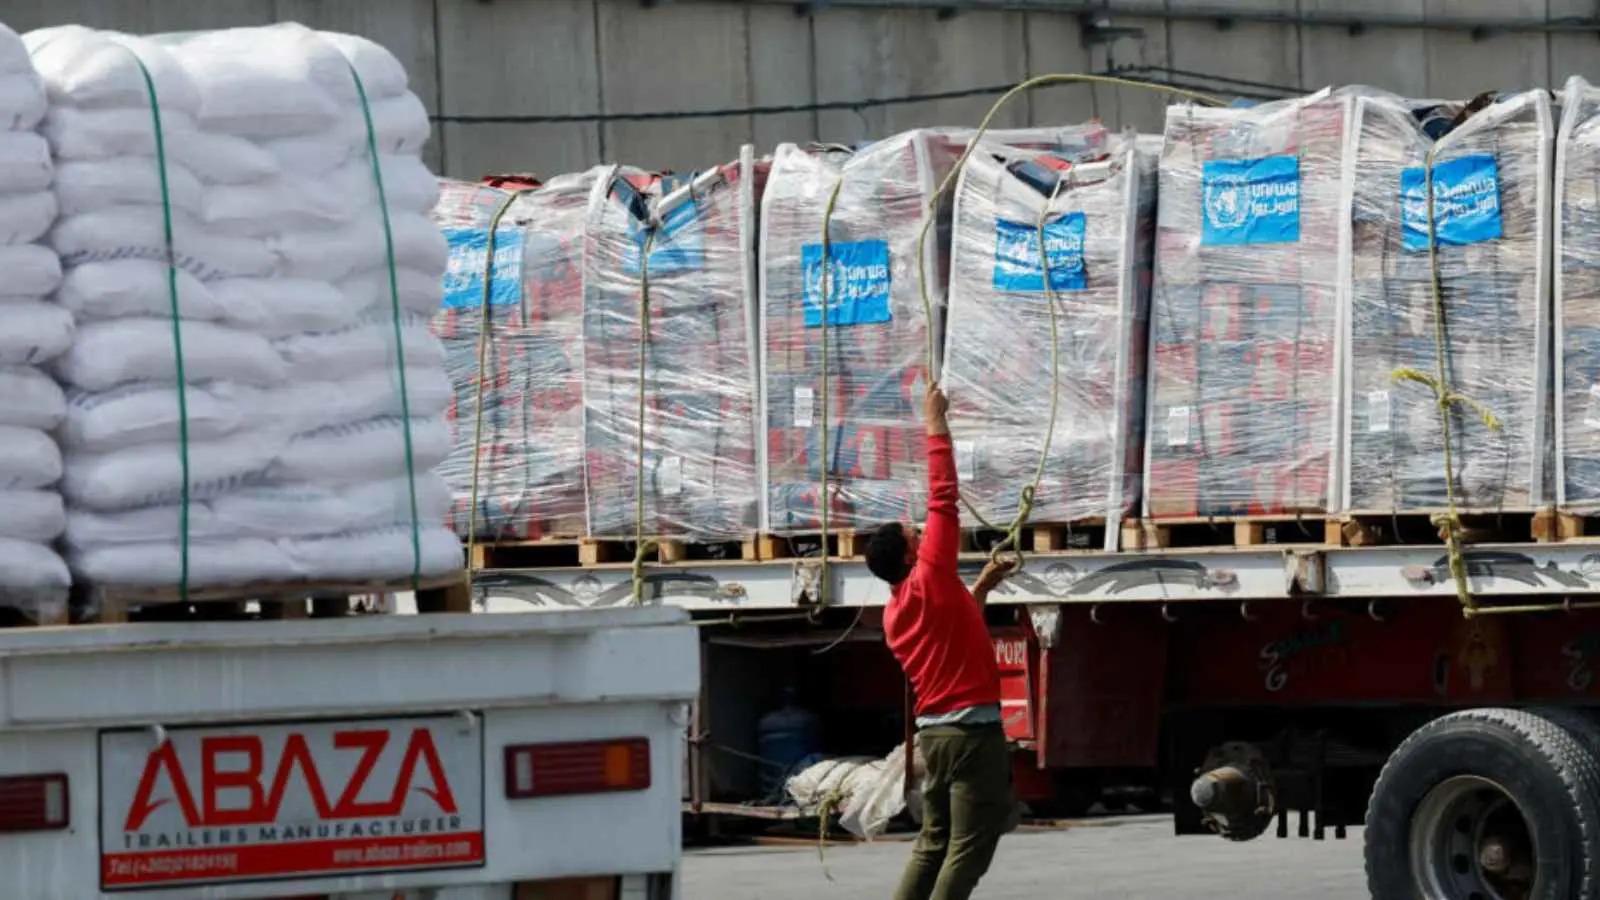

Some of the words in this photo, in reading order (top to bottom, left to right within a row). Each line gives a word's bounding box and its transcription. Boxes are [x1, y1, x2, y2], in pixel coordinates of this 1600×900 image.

[123, 728, 459, 832] ABAZA
[124, 828, 248, 849] TRAILERS
[259, 816, 462, 841] MANUFACTURER
